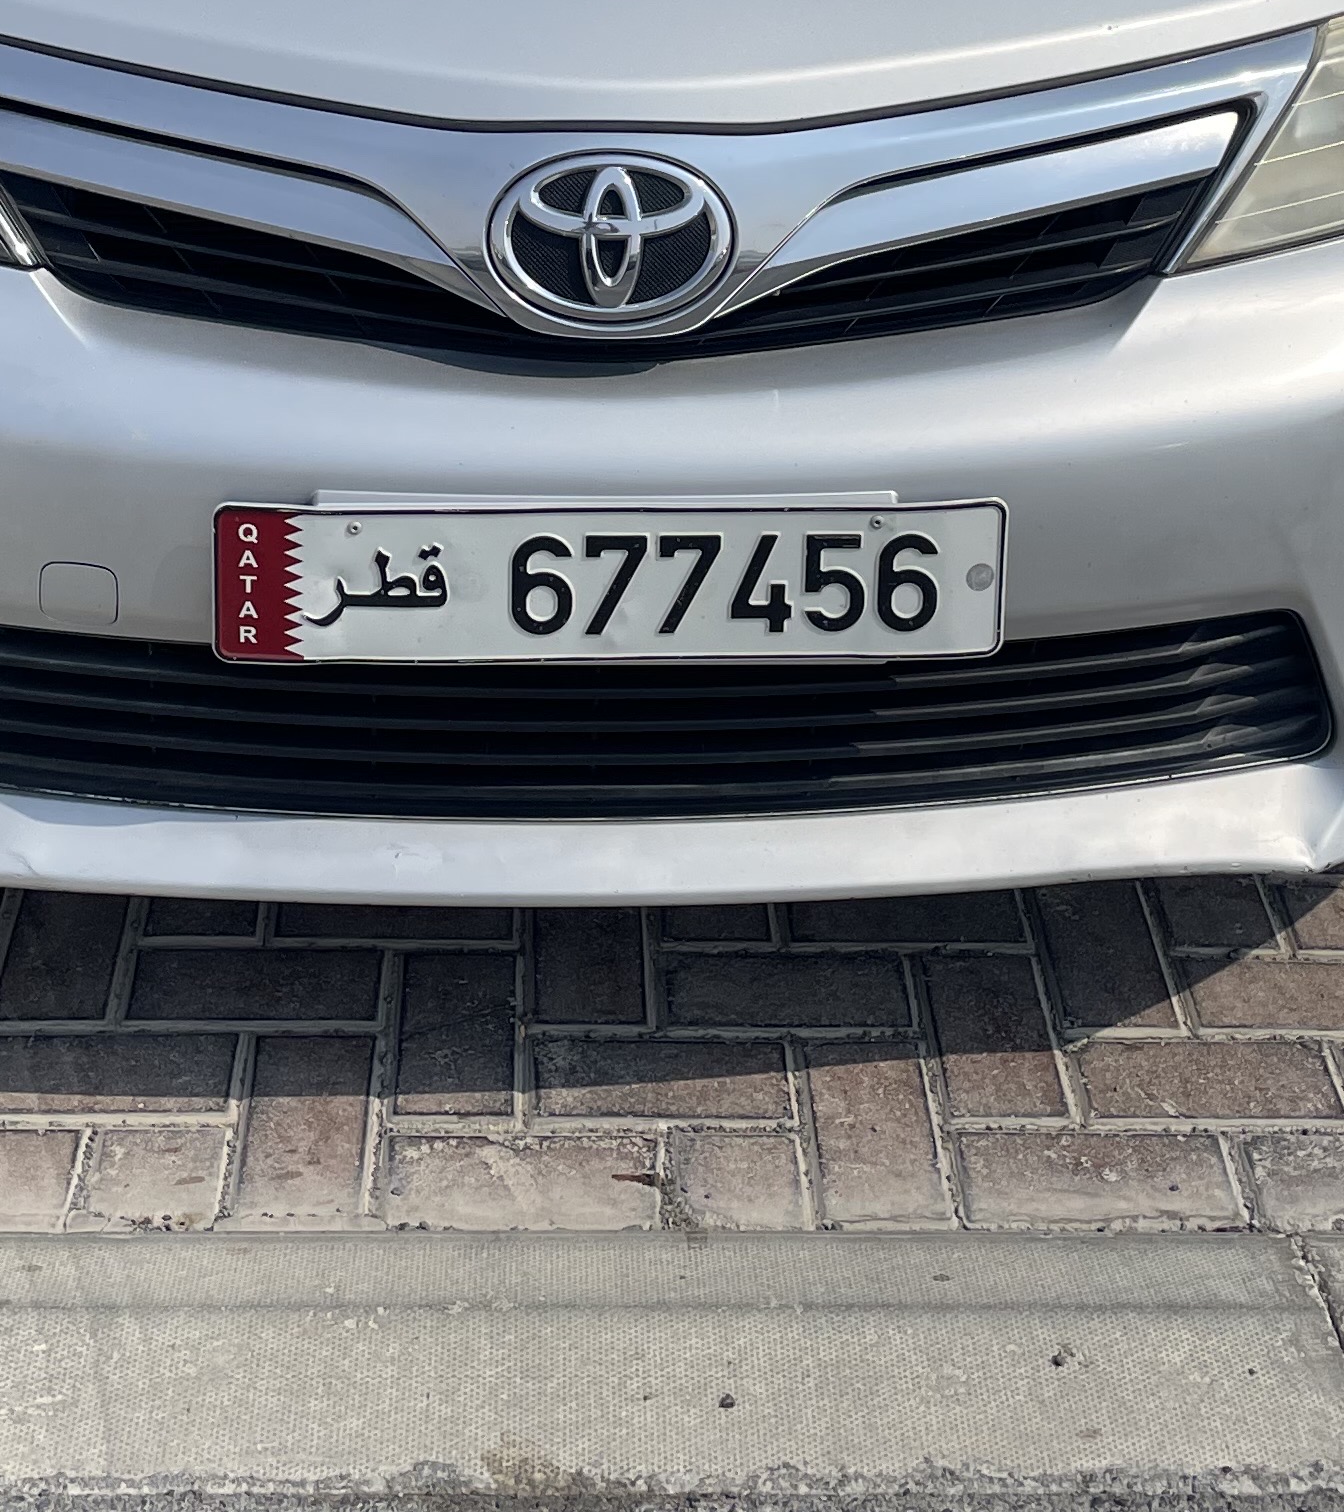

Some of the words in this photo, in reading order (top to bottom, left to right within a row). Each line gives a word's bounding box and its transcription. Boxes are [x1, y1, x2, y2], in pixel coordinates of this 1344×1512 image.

[237, 522, 259, 645] QATAR
[302, 542, 449, 627] قطر
[509, 532, 941, 636] 677456
